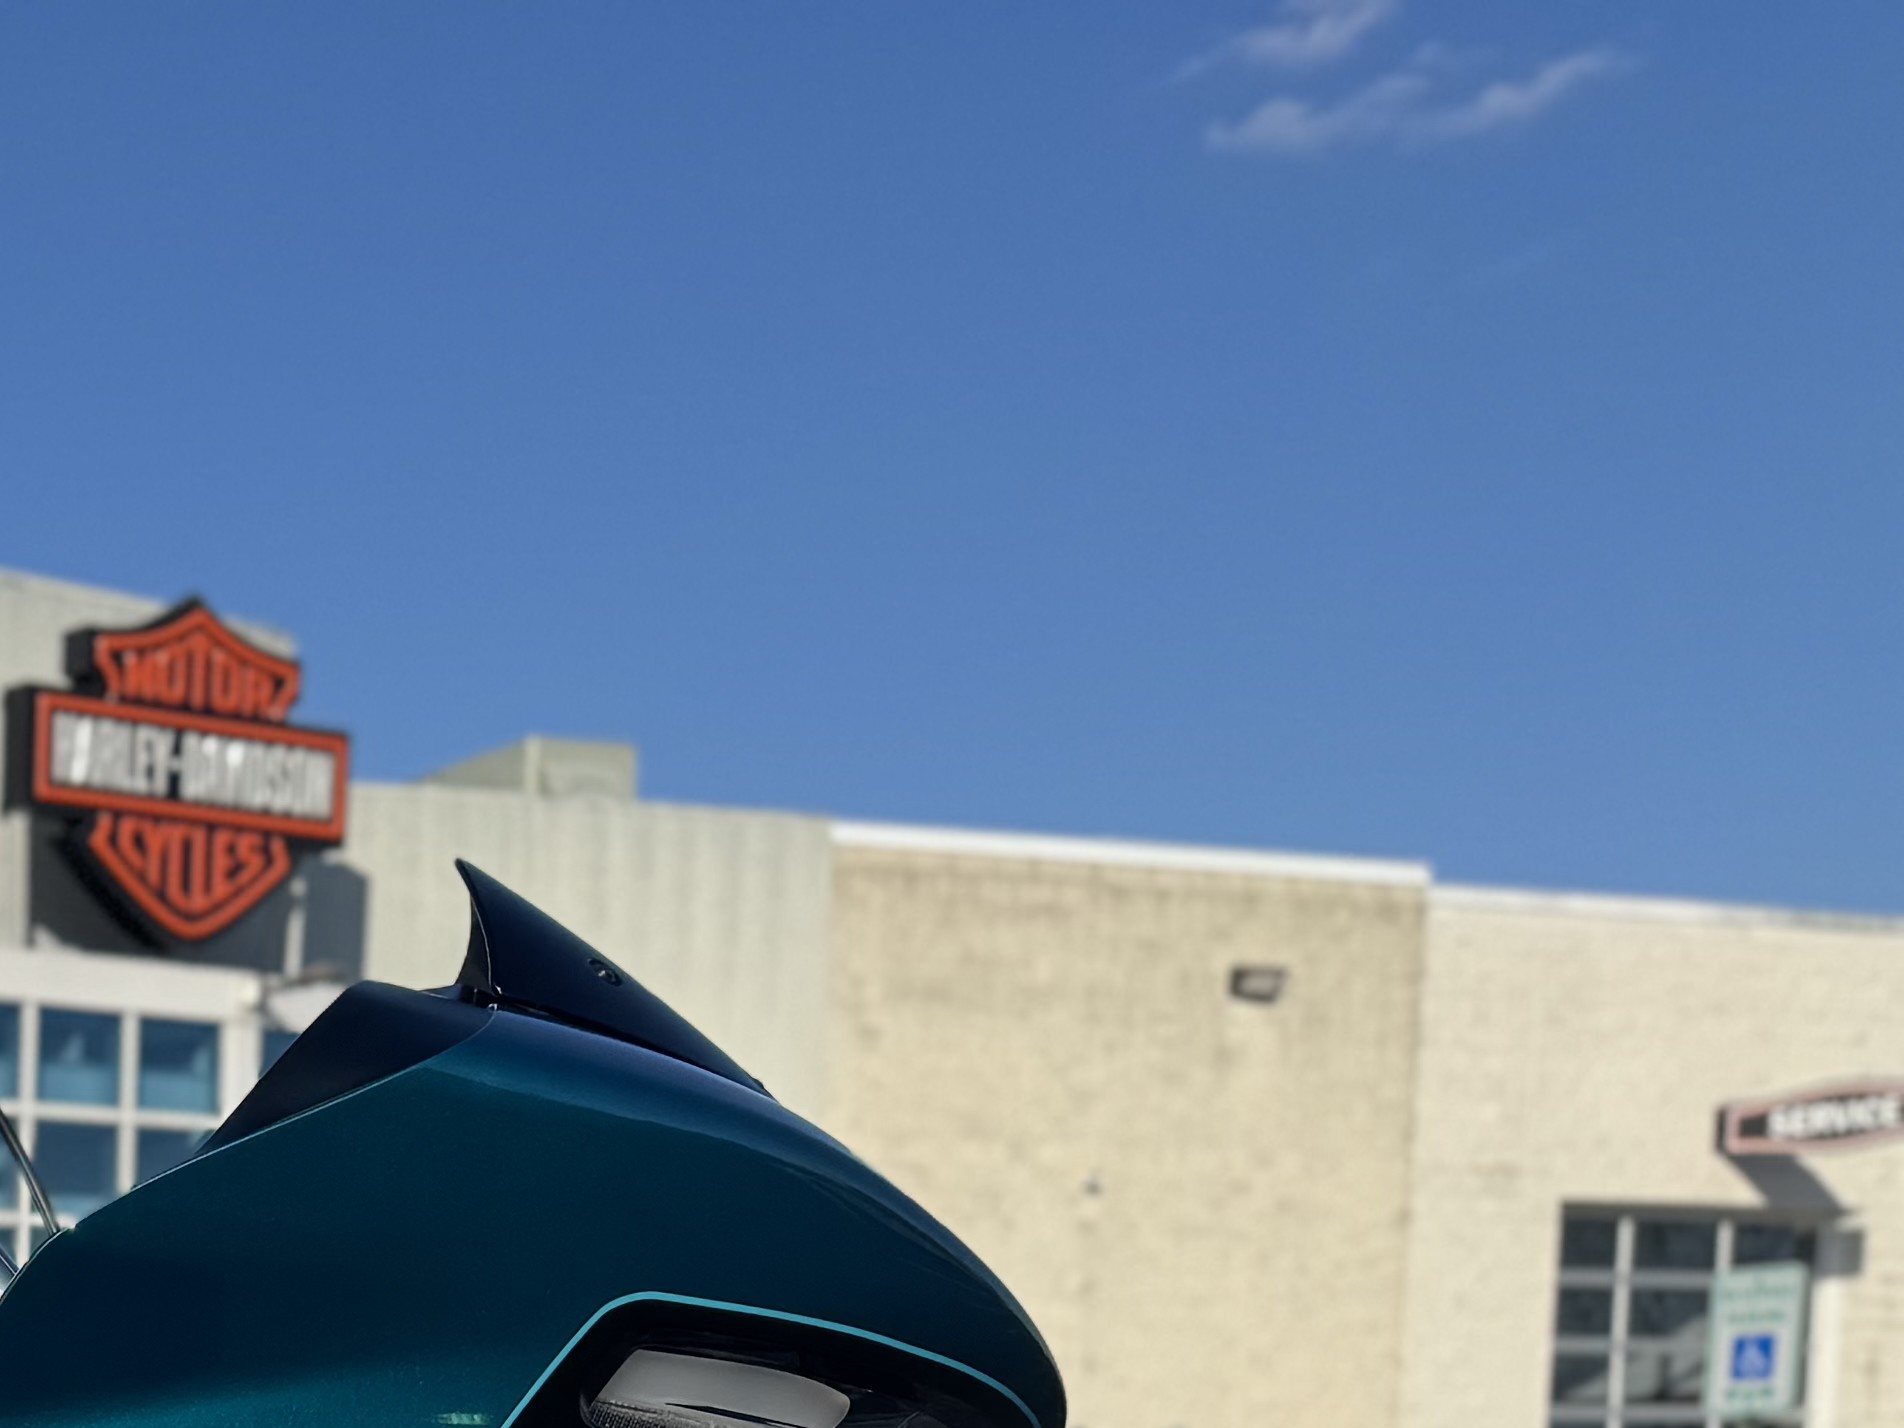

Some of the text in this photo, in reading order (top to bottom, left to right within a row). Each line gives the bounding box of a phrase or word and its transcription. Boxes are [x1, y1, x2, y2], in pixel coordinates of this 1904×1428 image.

[122, 636, 274, 718] MOTOR
[117, 815, 266, 915] CYCLES
[1767, 1091, 1900, 1138] SERVICE
